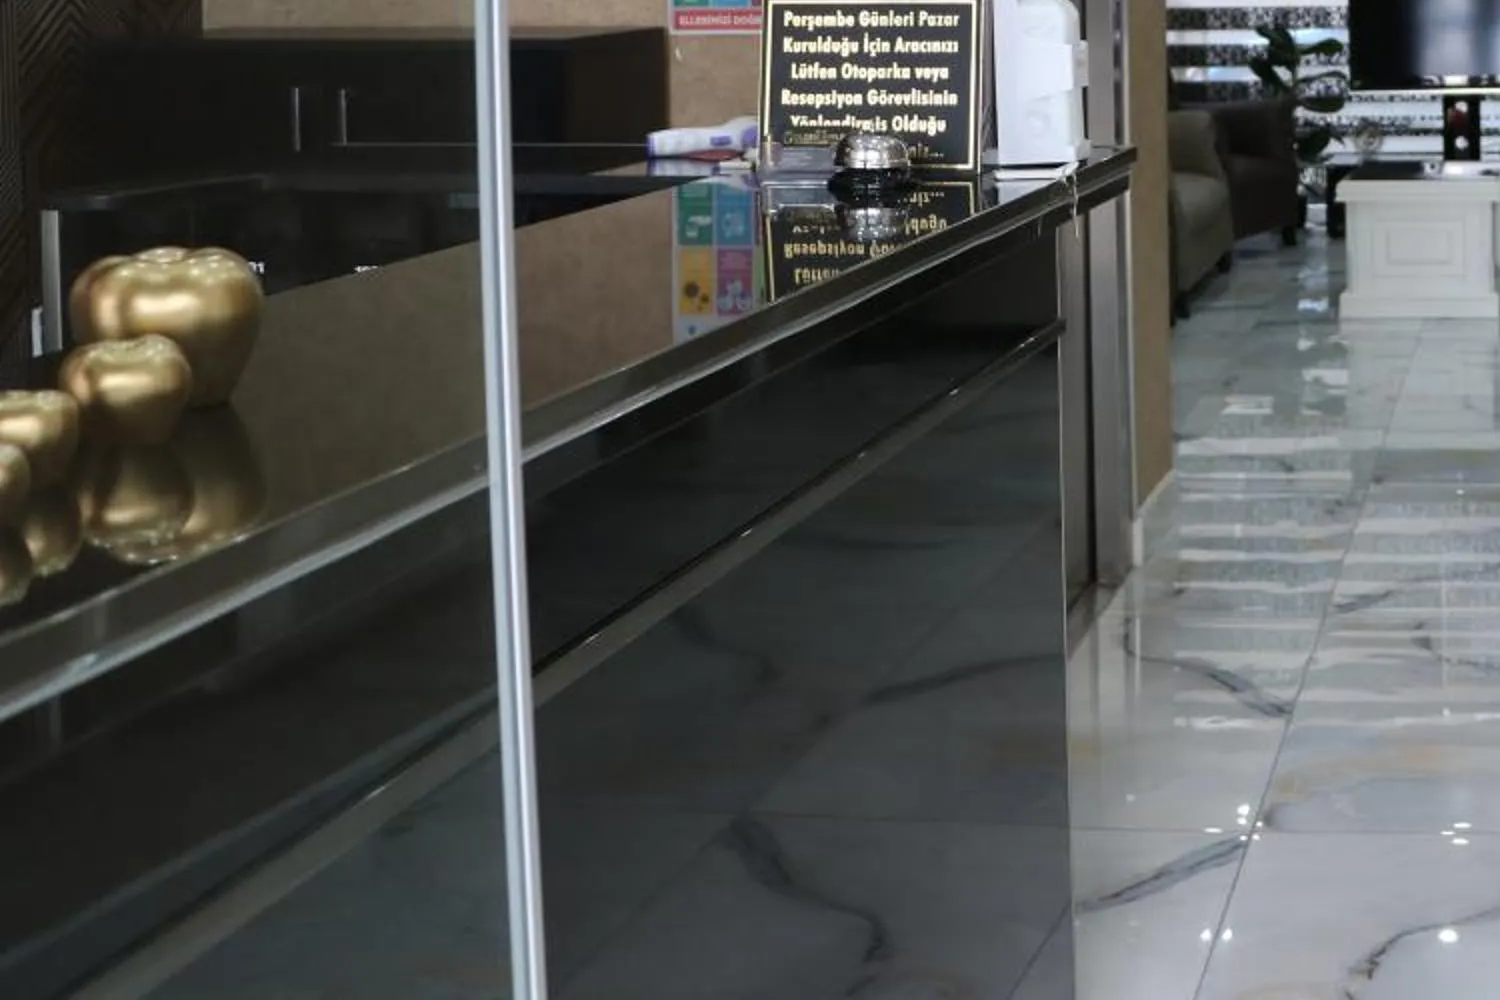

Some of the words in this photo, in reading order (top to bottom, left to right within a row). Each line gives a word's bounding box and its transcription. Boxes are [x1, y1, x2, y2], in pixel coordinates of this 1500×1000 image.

[784, 10, 854, 31] Perşembe
[858, 10, 915, 27] Günleri
[919, 10, 960, 27] Pazar
[783, 36, 858, 57] Kurulduğu
[863, 32, 890, 57] İçin
[894, 36, 959, 53] Aracınızı
[791, 63, 837, 80] Lütfen
[841, 63, 911, 82] Otoparka
[915, 66, 949, 83] veya
[781, 89, 863, 109] Resepsiyon
[867, 88, 958, 106] Görevlisinin
[892, 114, 947, 136] Olduğu
